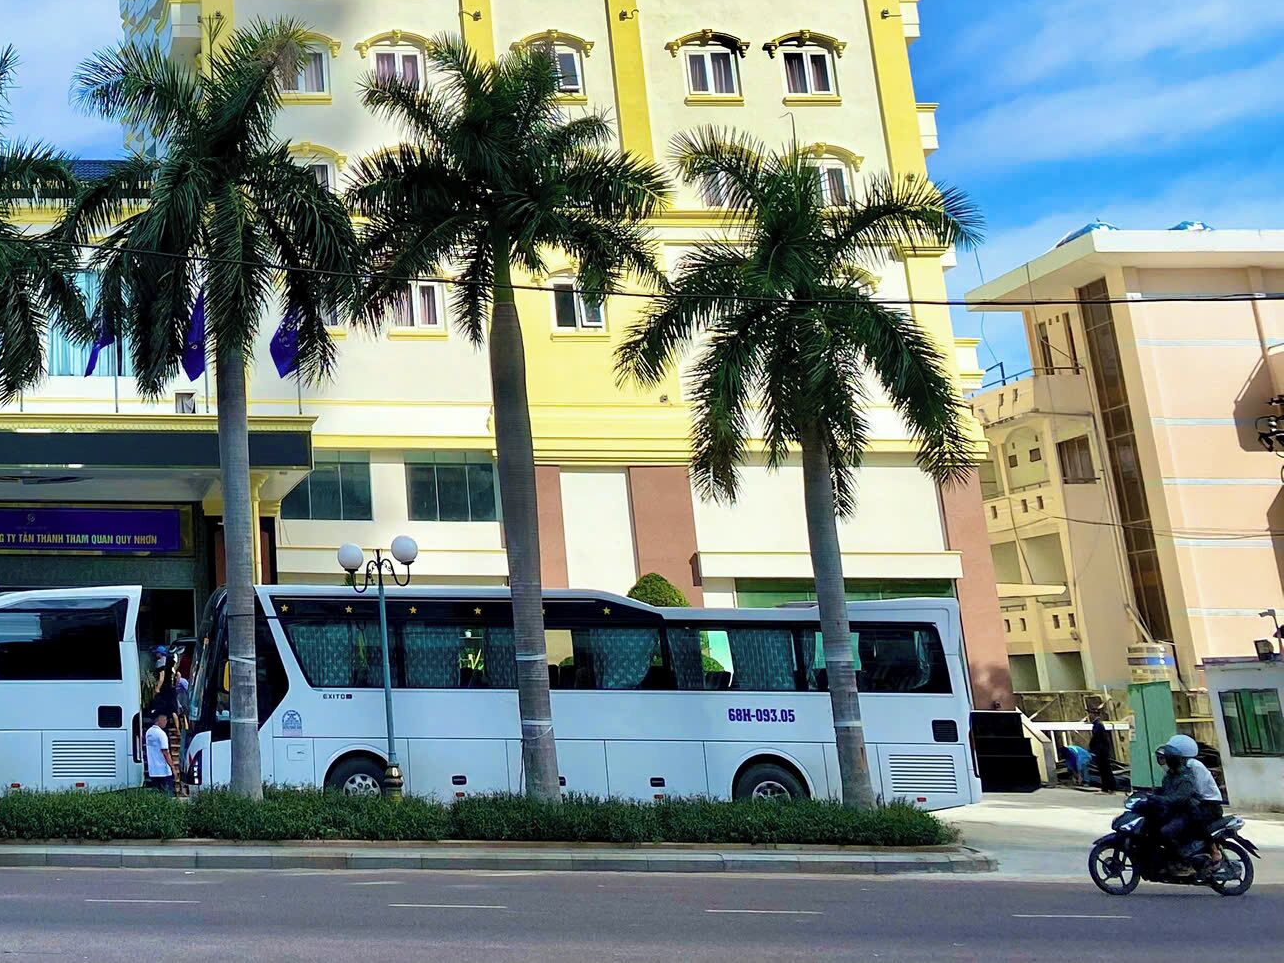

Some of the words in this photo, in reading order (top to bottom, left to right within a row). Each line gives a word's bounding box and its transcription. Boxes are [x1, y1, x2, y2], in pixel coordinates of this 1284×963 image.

[6, 533, 16, 543] TY
[66, 533, 89, 544] THAM
[91, 534, 113, 545] QUAN
[116, 534, 131, 545] QUY
[728, 708, 795, 722] 68H-093.05
